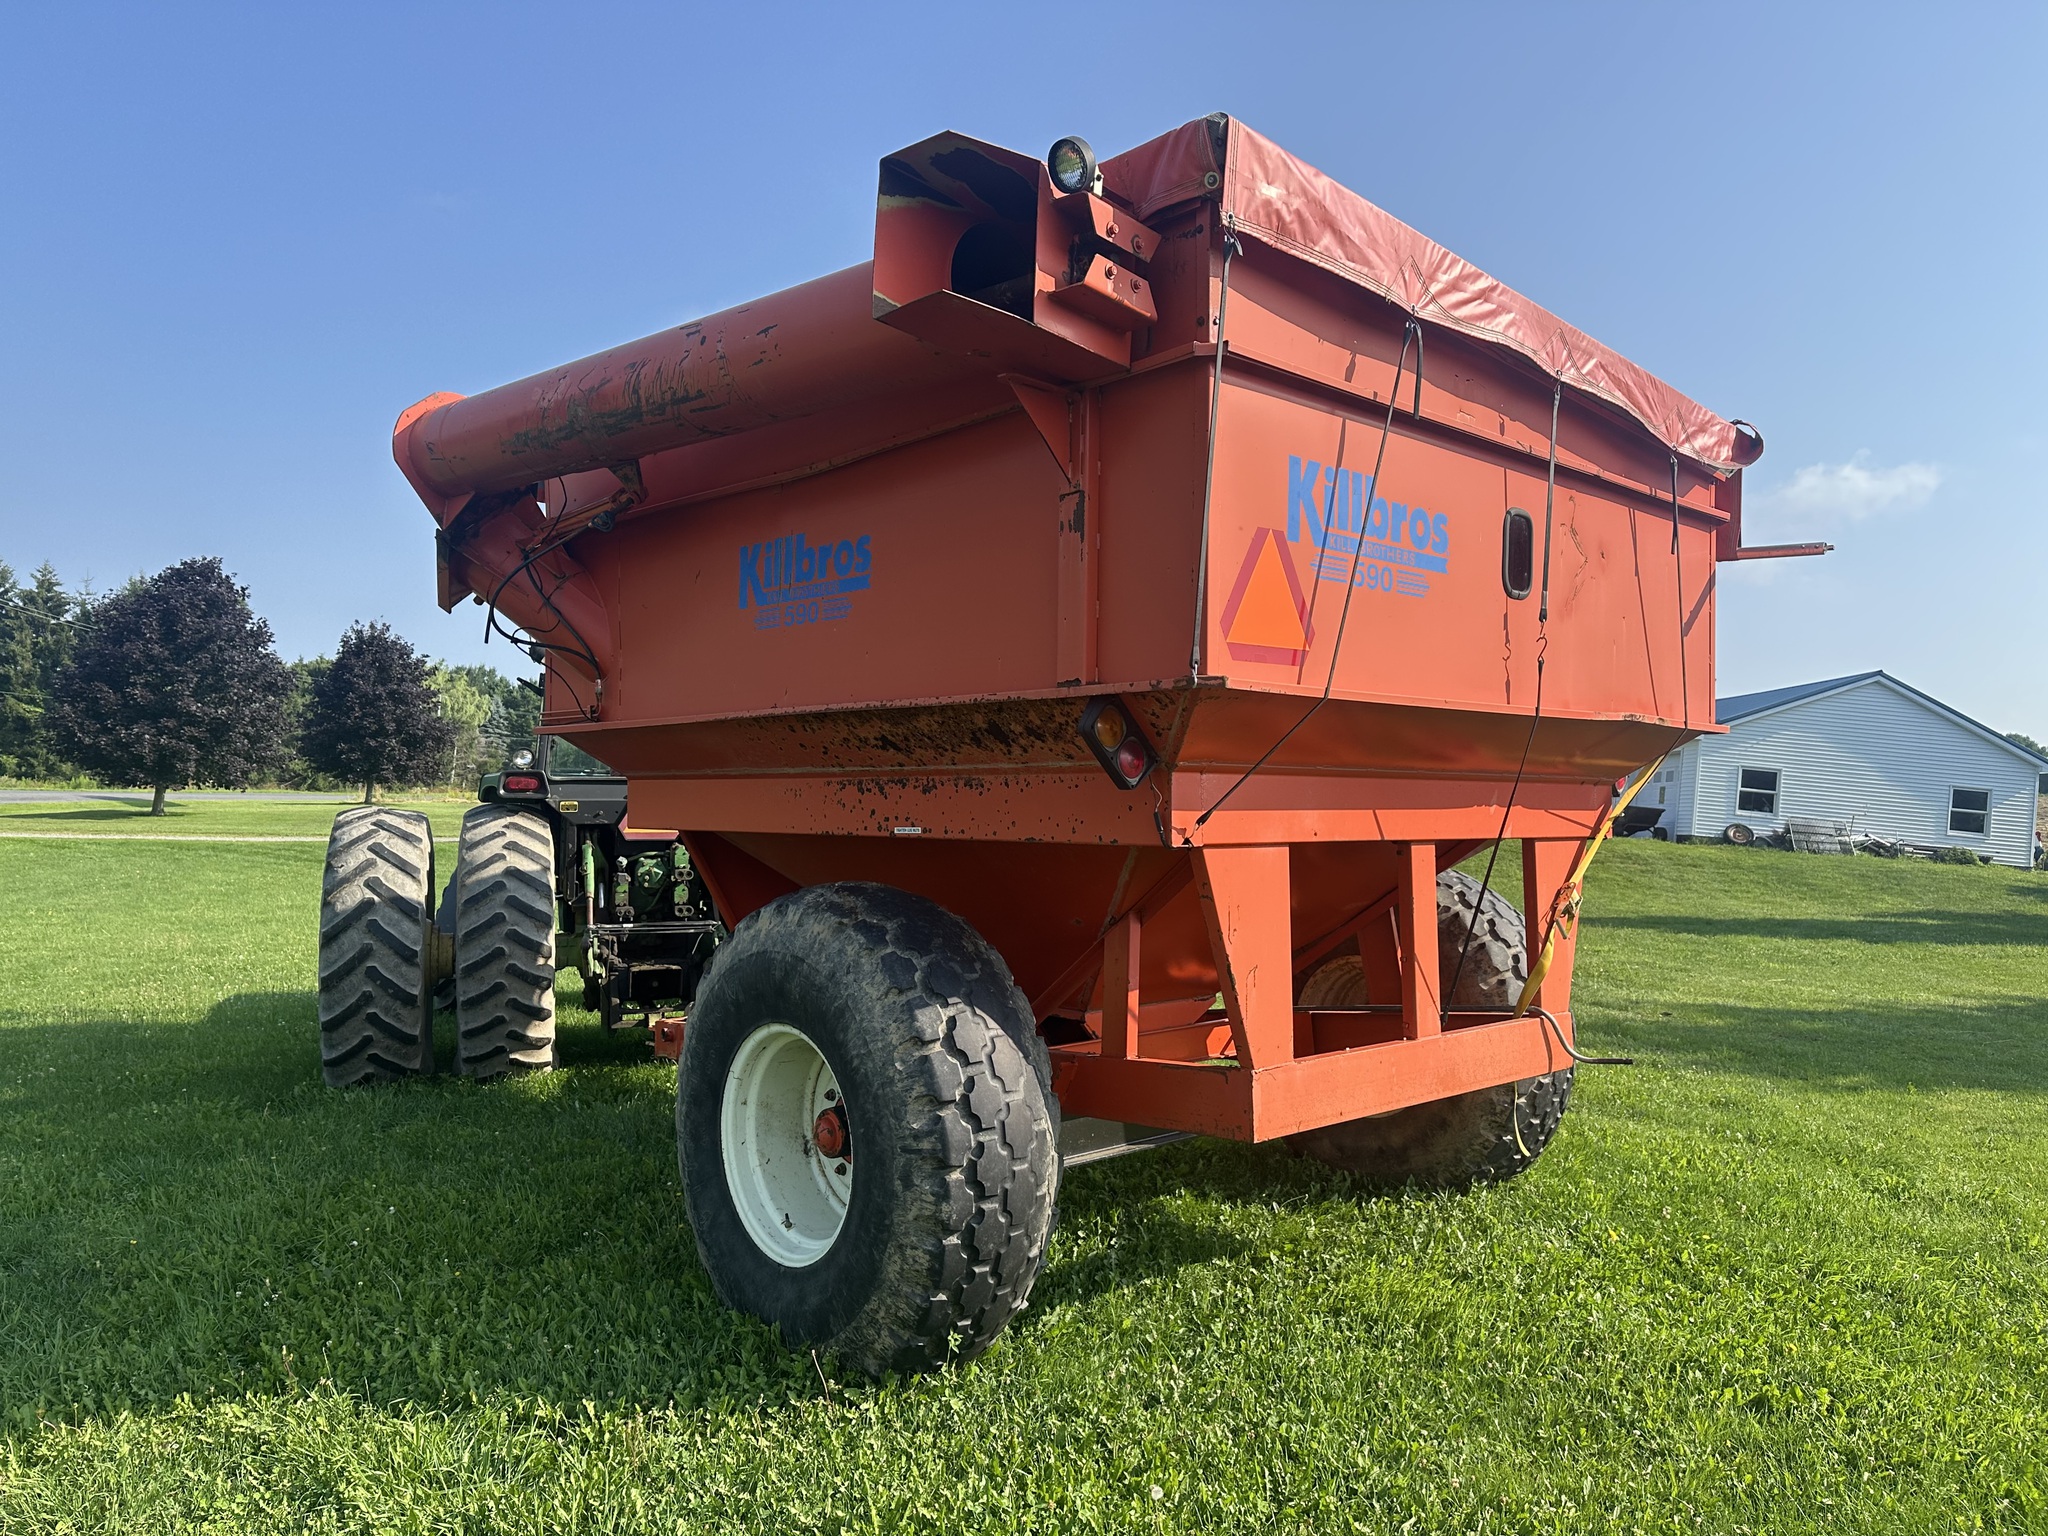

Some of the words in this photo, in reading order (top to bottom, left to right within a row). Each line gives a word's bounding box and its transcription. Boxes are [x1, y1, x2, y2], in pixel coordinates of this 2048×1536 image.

[1287, 454, 1449, 554] Killbros
[1329, 535, 1354, 552] KILL
[738, 533, 872, 610] Killbros
[1353, 562, 1394, 592] 590
[784, 601, 819, 627] 590
